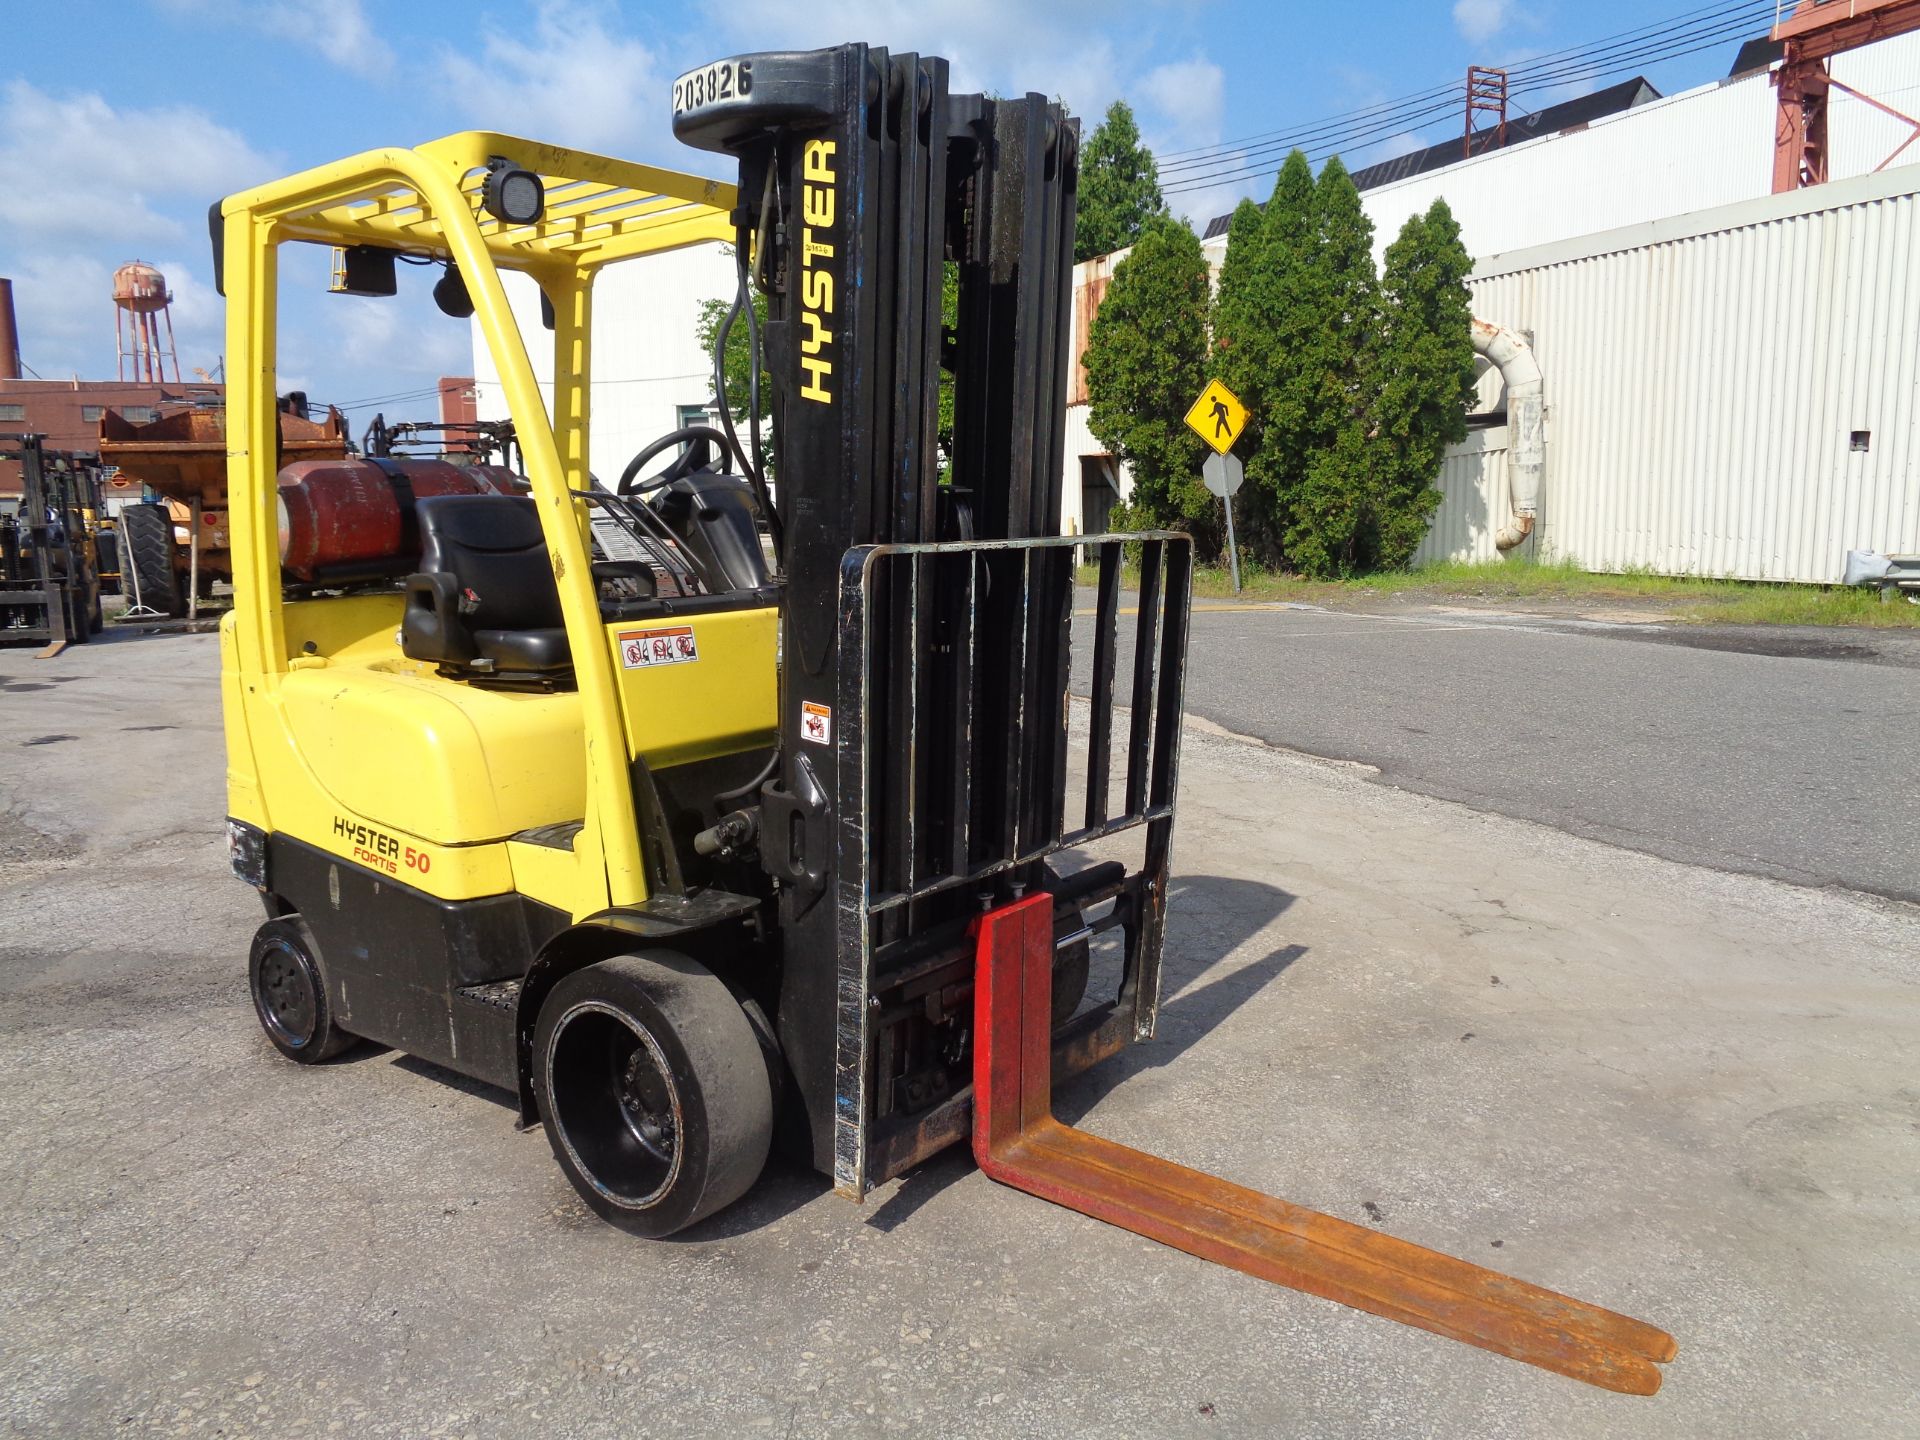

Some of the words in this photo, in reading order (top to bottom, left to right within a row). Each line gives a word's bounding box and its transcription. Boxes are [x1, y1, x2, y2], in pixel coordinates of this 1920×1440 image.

[675, 61, 753, 115] 203826
[801, 139, 836, 404] HYSTER
[333, 815, 399, 859] HYSTER
[405, 846, 430, 873] 50
[353, 847, 397, 874] FORTIS
